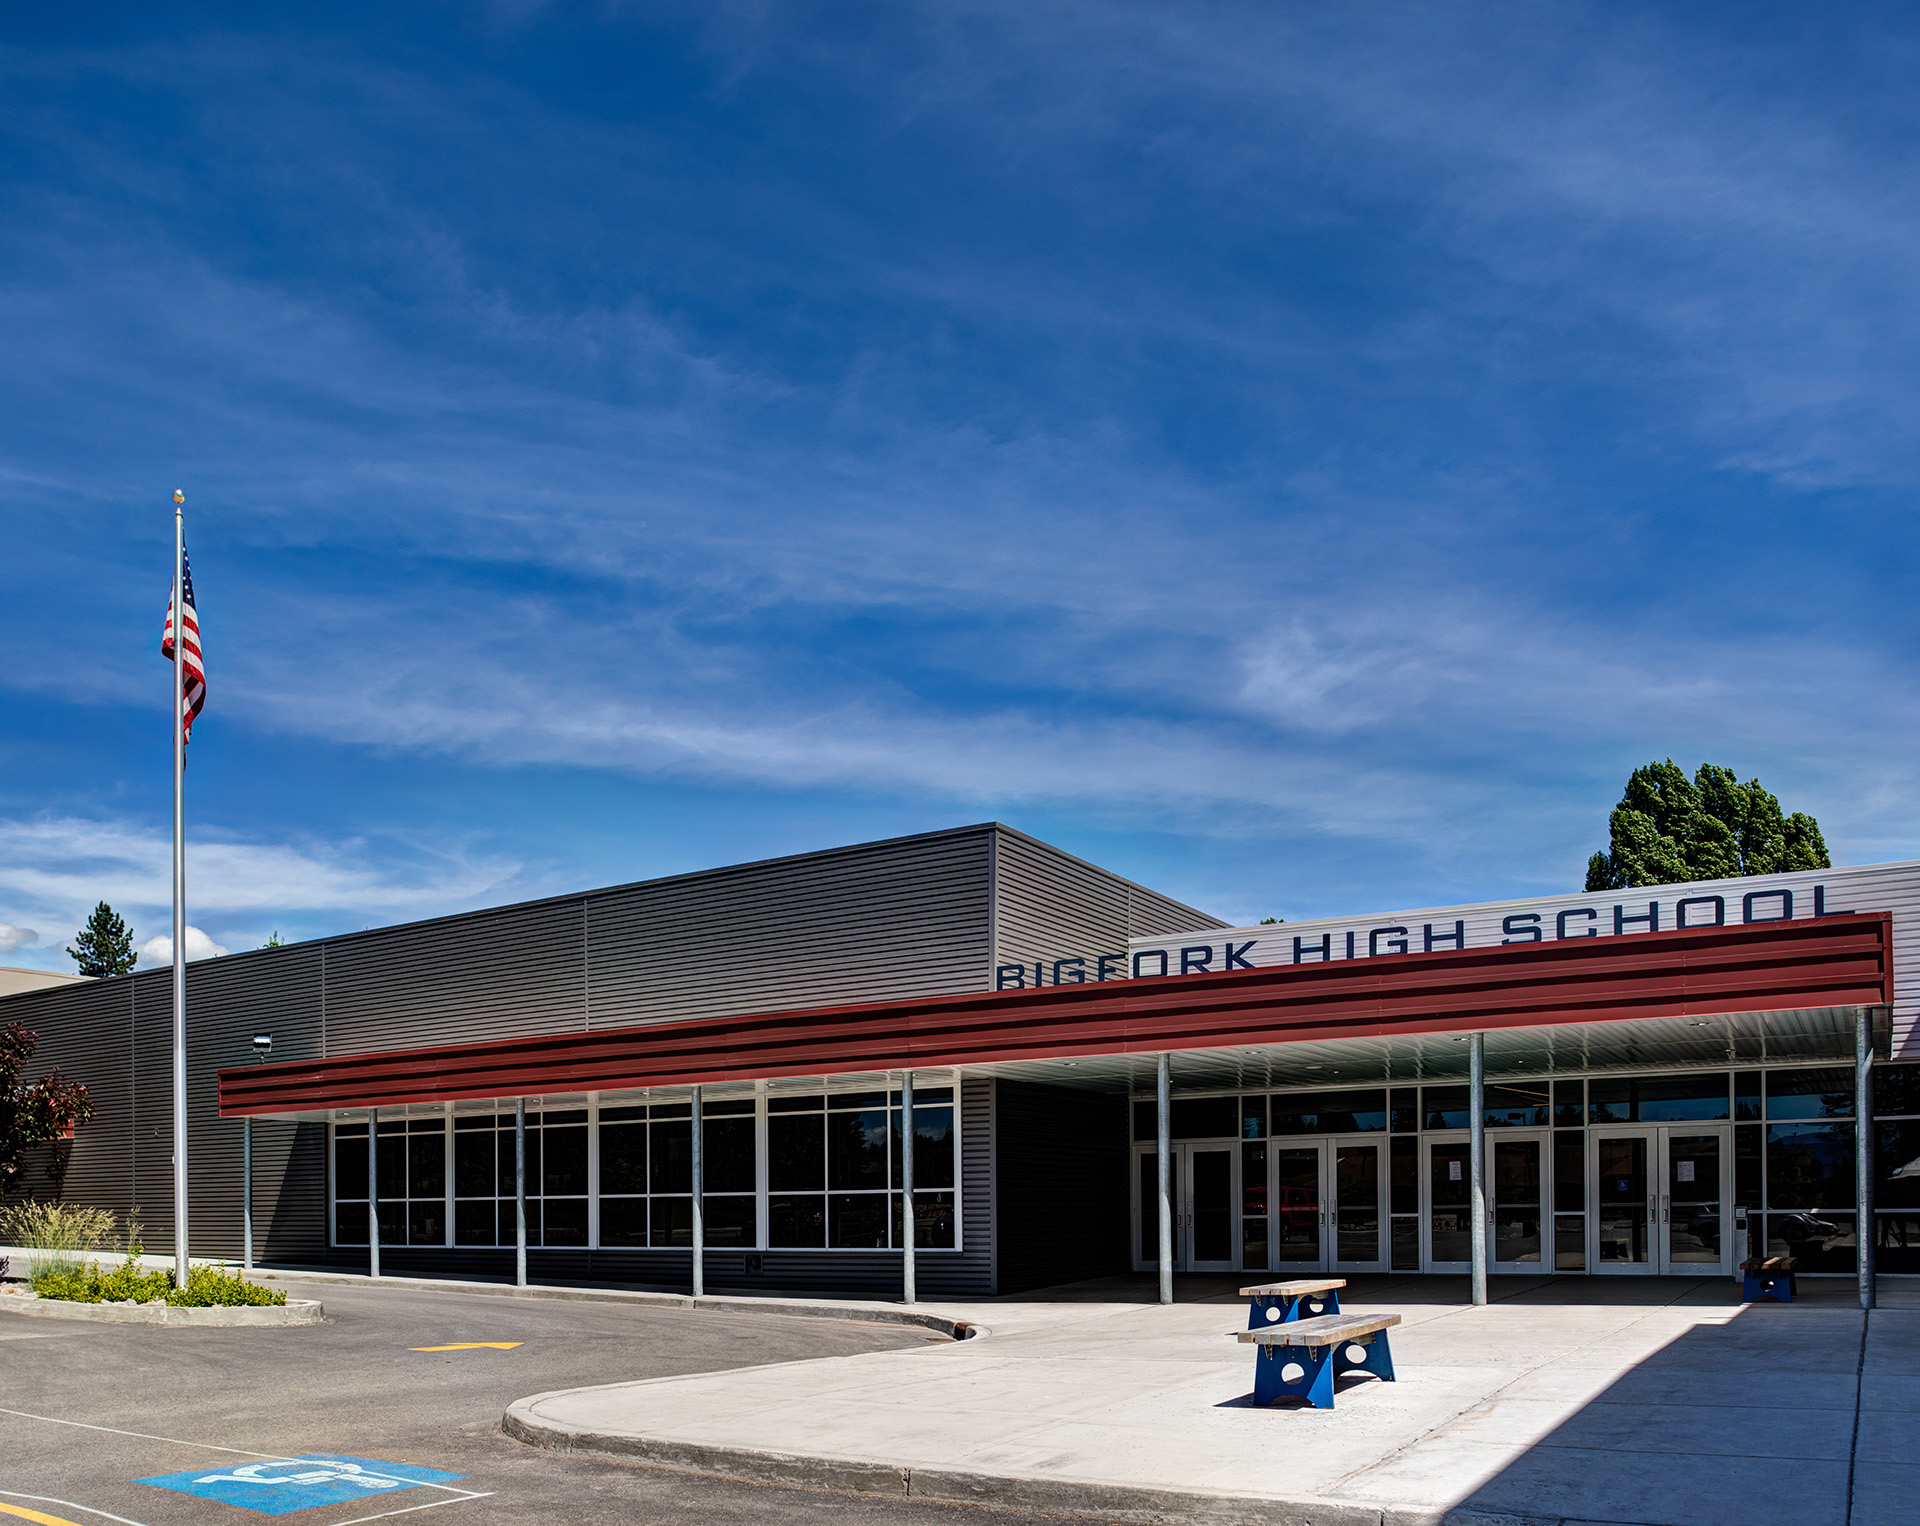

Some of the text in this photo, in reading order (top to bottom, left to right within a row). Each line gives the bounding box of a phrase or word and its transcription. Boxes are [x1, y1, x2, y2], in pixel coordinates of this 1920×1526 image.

[997, 885, 1855, 991] BIGFORK HIGH SCHOOL
